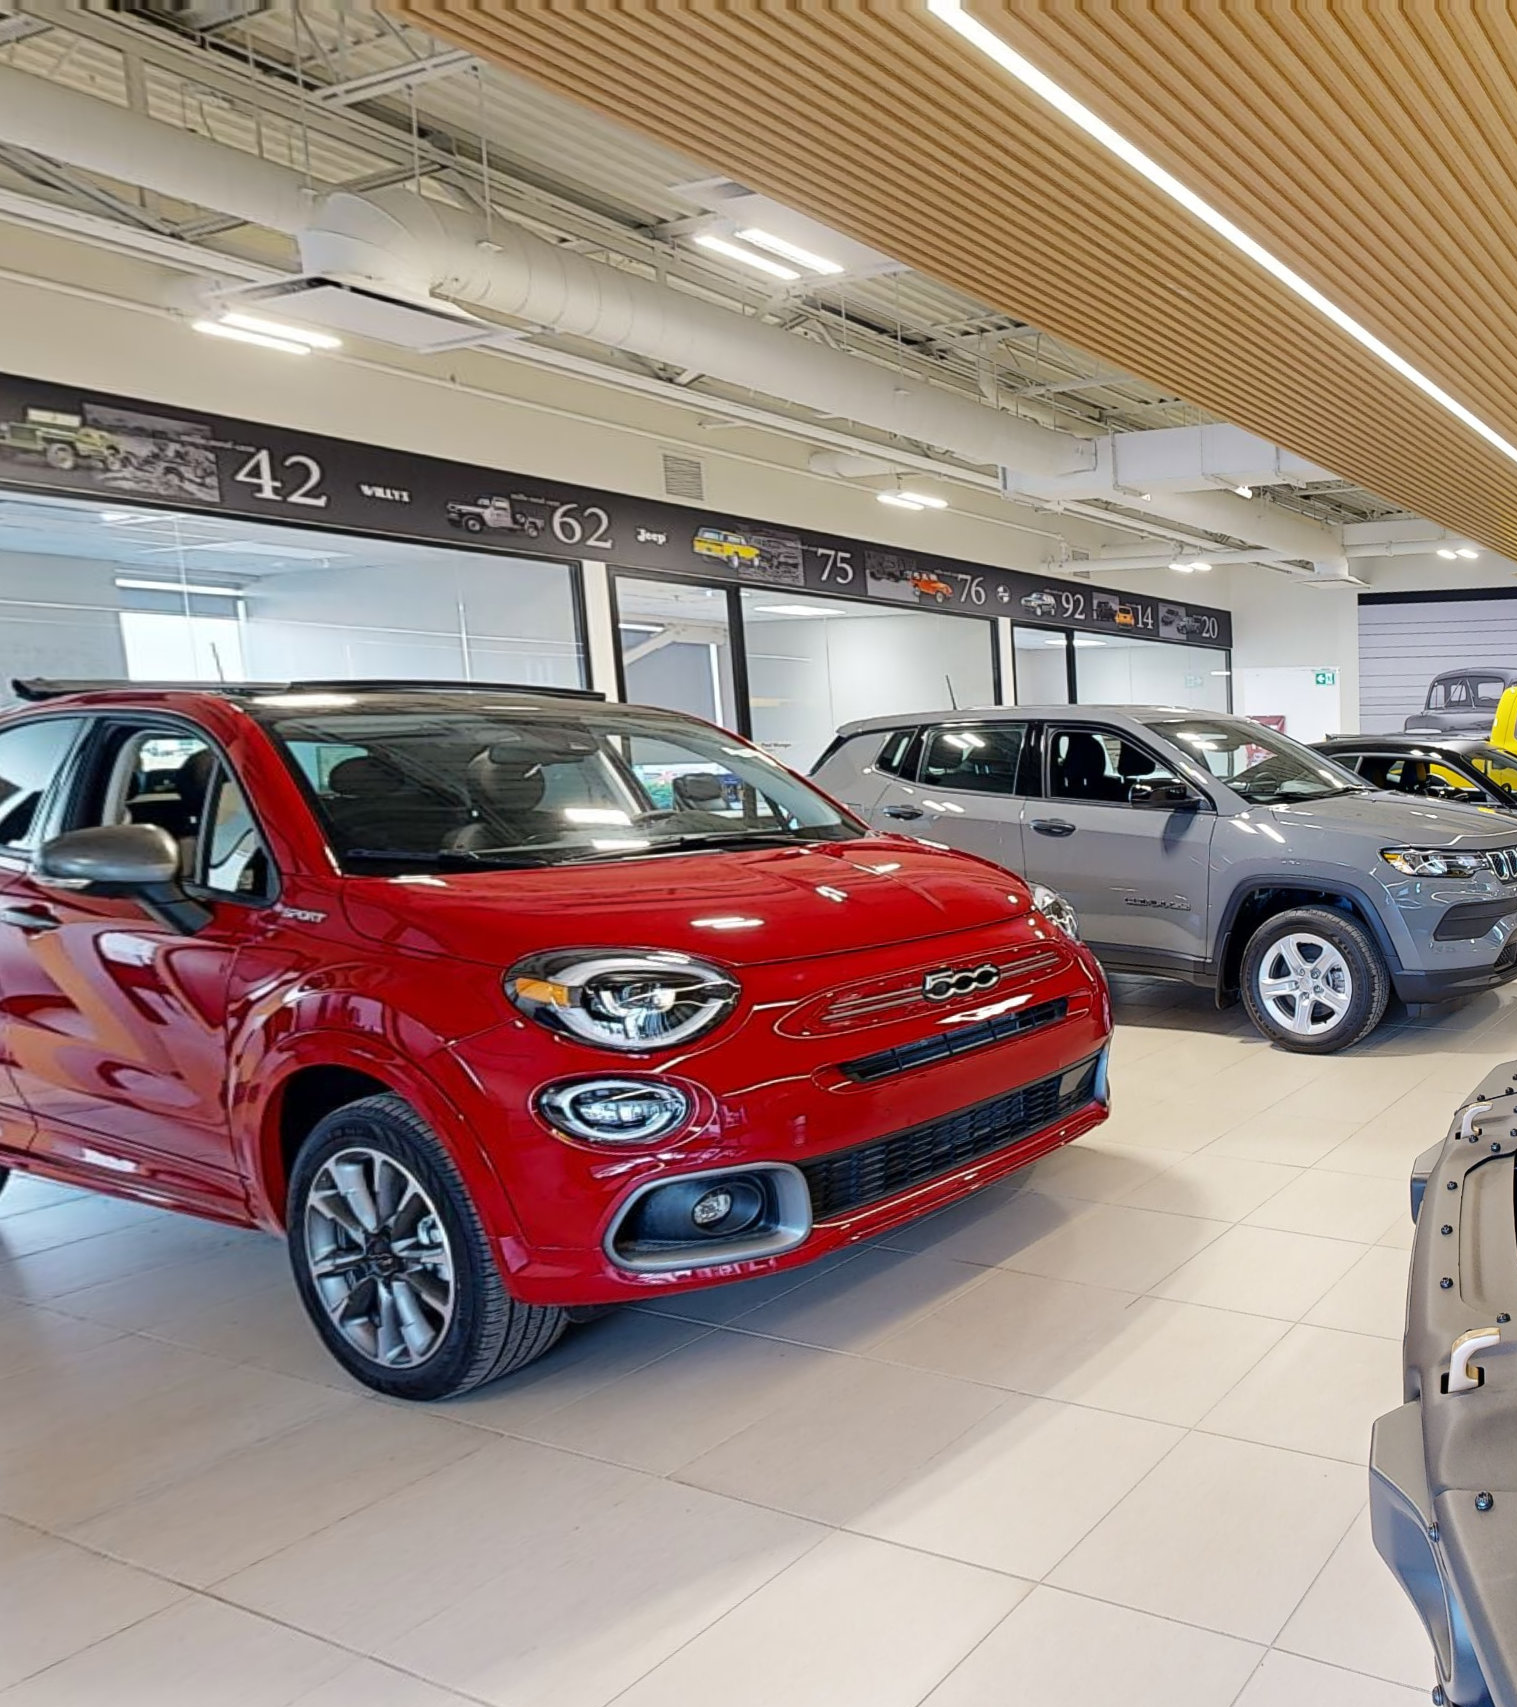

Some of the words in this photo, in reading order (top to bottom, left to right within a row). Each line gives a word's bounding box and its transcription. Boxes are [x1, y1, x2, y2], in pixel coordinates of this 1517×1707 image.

[234, 449, 328, 507] 42
[552, 503, 613, 549] 62
[635, 527, 667, 545] Jeep
[816, 548, 854, 584] 75
[957, 574, 986, 605] 76
[1061, 592, 1086, 620] 92
[1137, 604, 1154, 629] 14
[1201, 615, 1219, 639] 20
[281, 907, 328, 923] SPORT
[923, 963, 1000, 1002] 500
